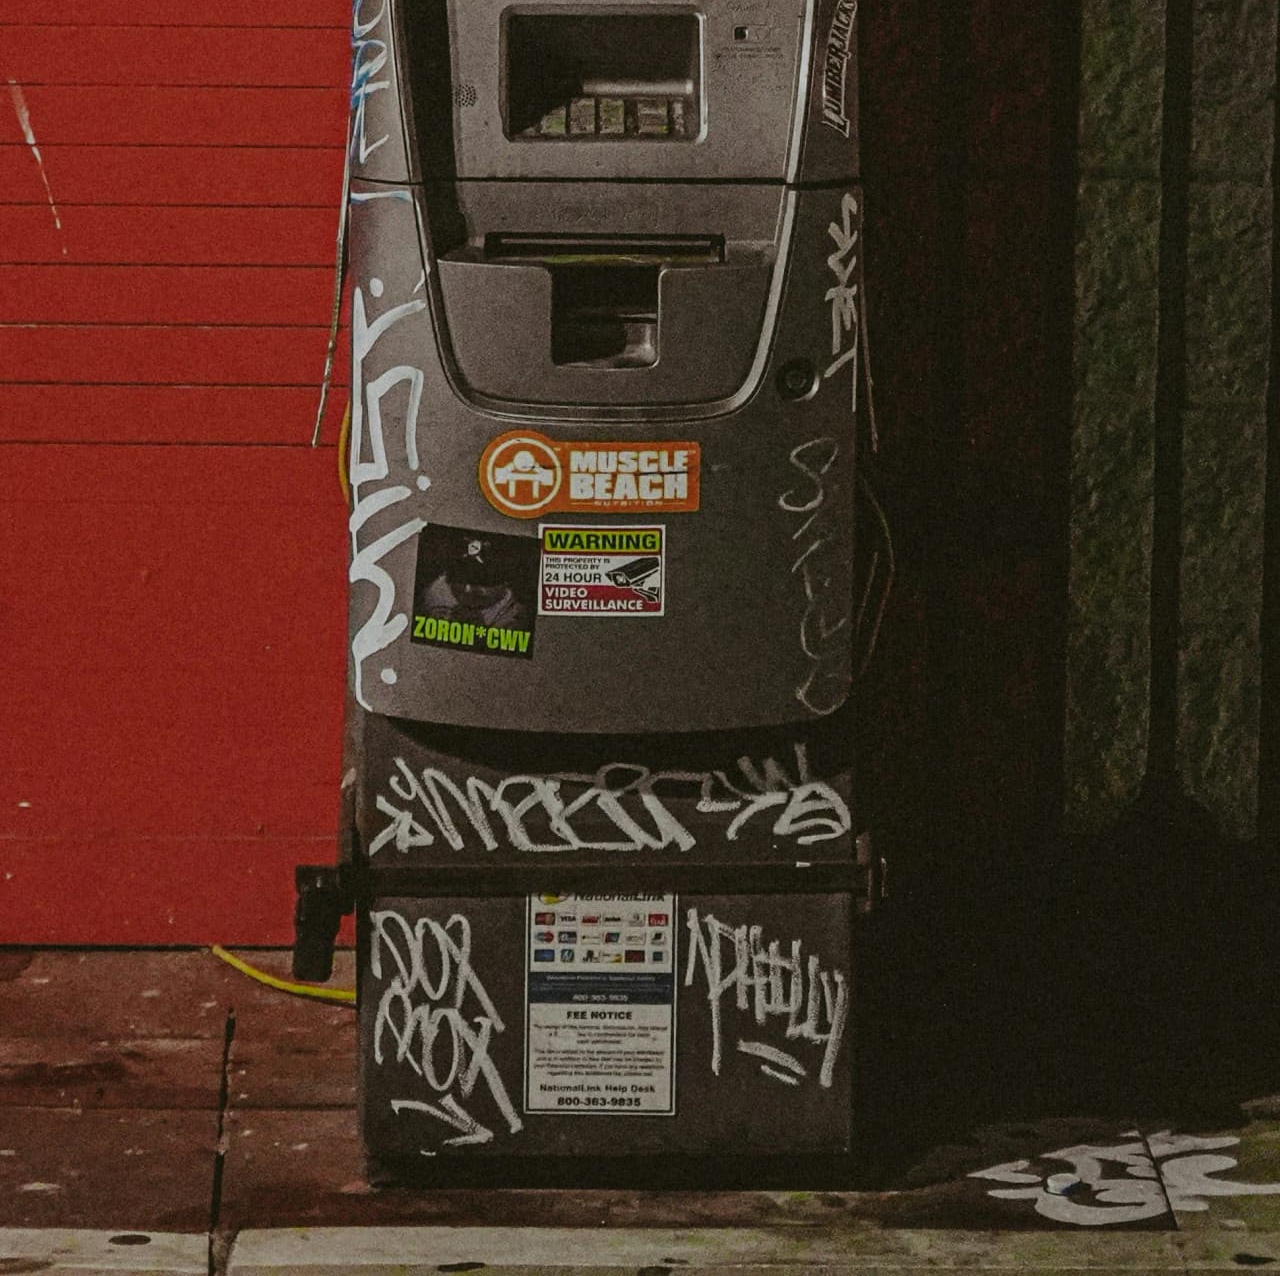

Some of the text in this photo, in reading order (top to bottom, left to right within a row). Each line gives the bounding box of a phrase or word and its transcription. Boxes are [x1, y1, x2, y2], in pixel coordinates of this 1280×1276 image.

[570, 450, 688, 472] MUSCLE
[570, 473, 688, 499] BEACH
[548, 532, 657, 550] WARNING
[545, 556, 561, 564] THIS
[563, 556, 602, 564] PROPERTY
[545, 572, 602, 583] 24 HOUR
[545, 587, 589, 598] VIDEO
[545, 599, 644, 611] SURVEILLANCE
[566, 1011, 632, 1020] FEE NOTICE
[540, 1084, 656, 1093] NationalLink Help Desk
